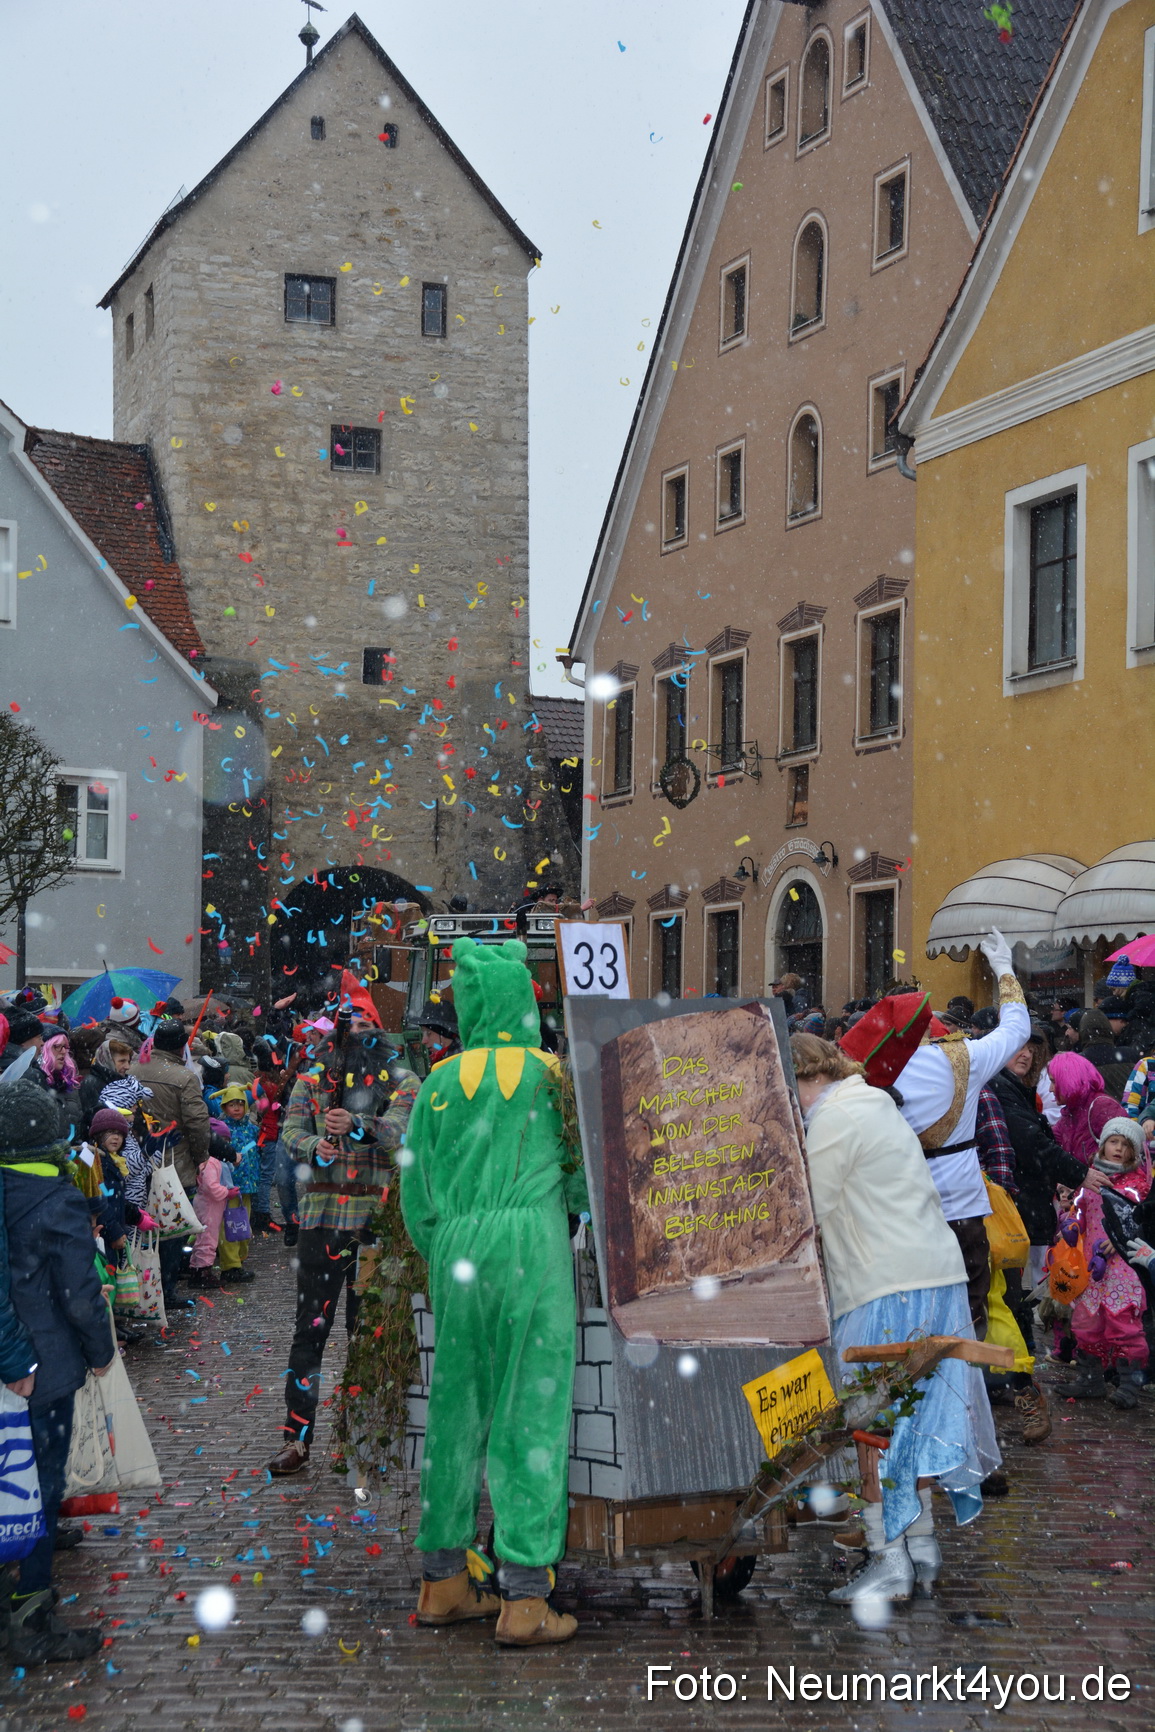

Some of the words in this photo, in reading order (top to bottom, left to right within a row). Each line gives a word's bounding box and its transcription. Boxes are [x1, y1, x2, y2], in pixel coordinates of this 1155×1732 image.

[573, 941, 619, 990] 33
[662, 1056, 709, 1079] DAS
[639, 1081, 744, 1115] MÄRCHEN
[653, 1119, 693, 1141] VON
[702, 1113, 743, 1136] DER
[653, 1142, 754, 1176] BELEBTEN
[648, 1168, 775, 1208] INNENSTADT
[665, 1202, 770, 1239] BERCHING
[756, 1386, 777, 1414] Es
[780, 1371, 811, 1400] war
